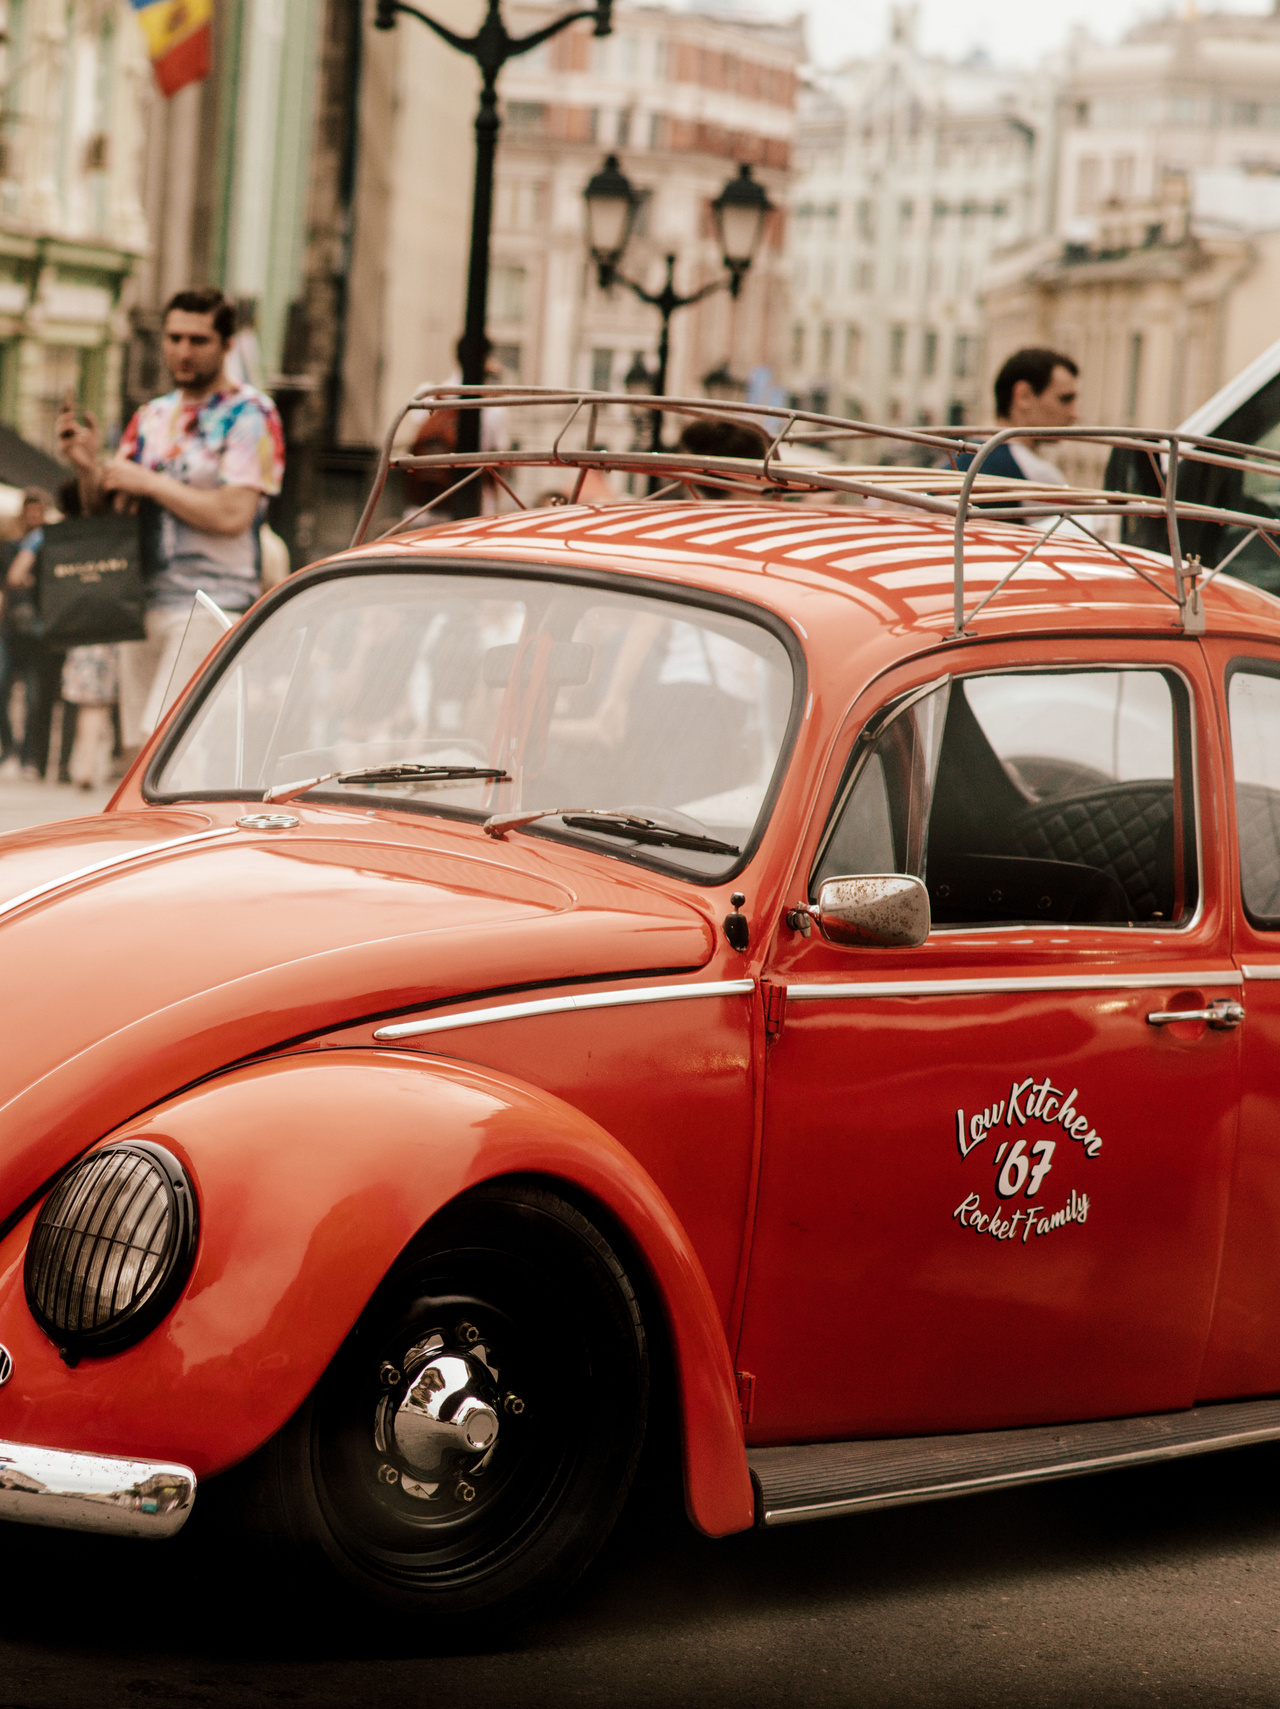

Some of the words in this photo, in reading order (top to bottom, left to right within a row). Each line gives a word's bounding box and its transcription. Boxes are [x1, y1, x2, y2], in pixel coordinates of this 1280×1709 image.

[956, 1100, 1005, 1160] Low
[1006, 1076, 1103, 1158] Kitchen
[993, 1139, 1056, 1199] '67
[953, 1192, 1027, 1241] Rocket
[1022, 1189, 1091, 1243] Family
